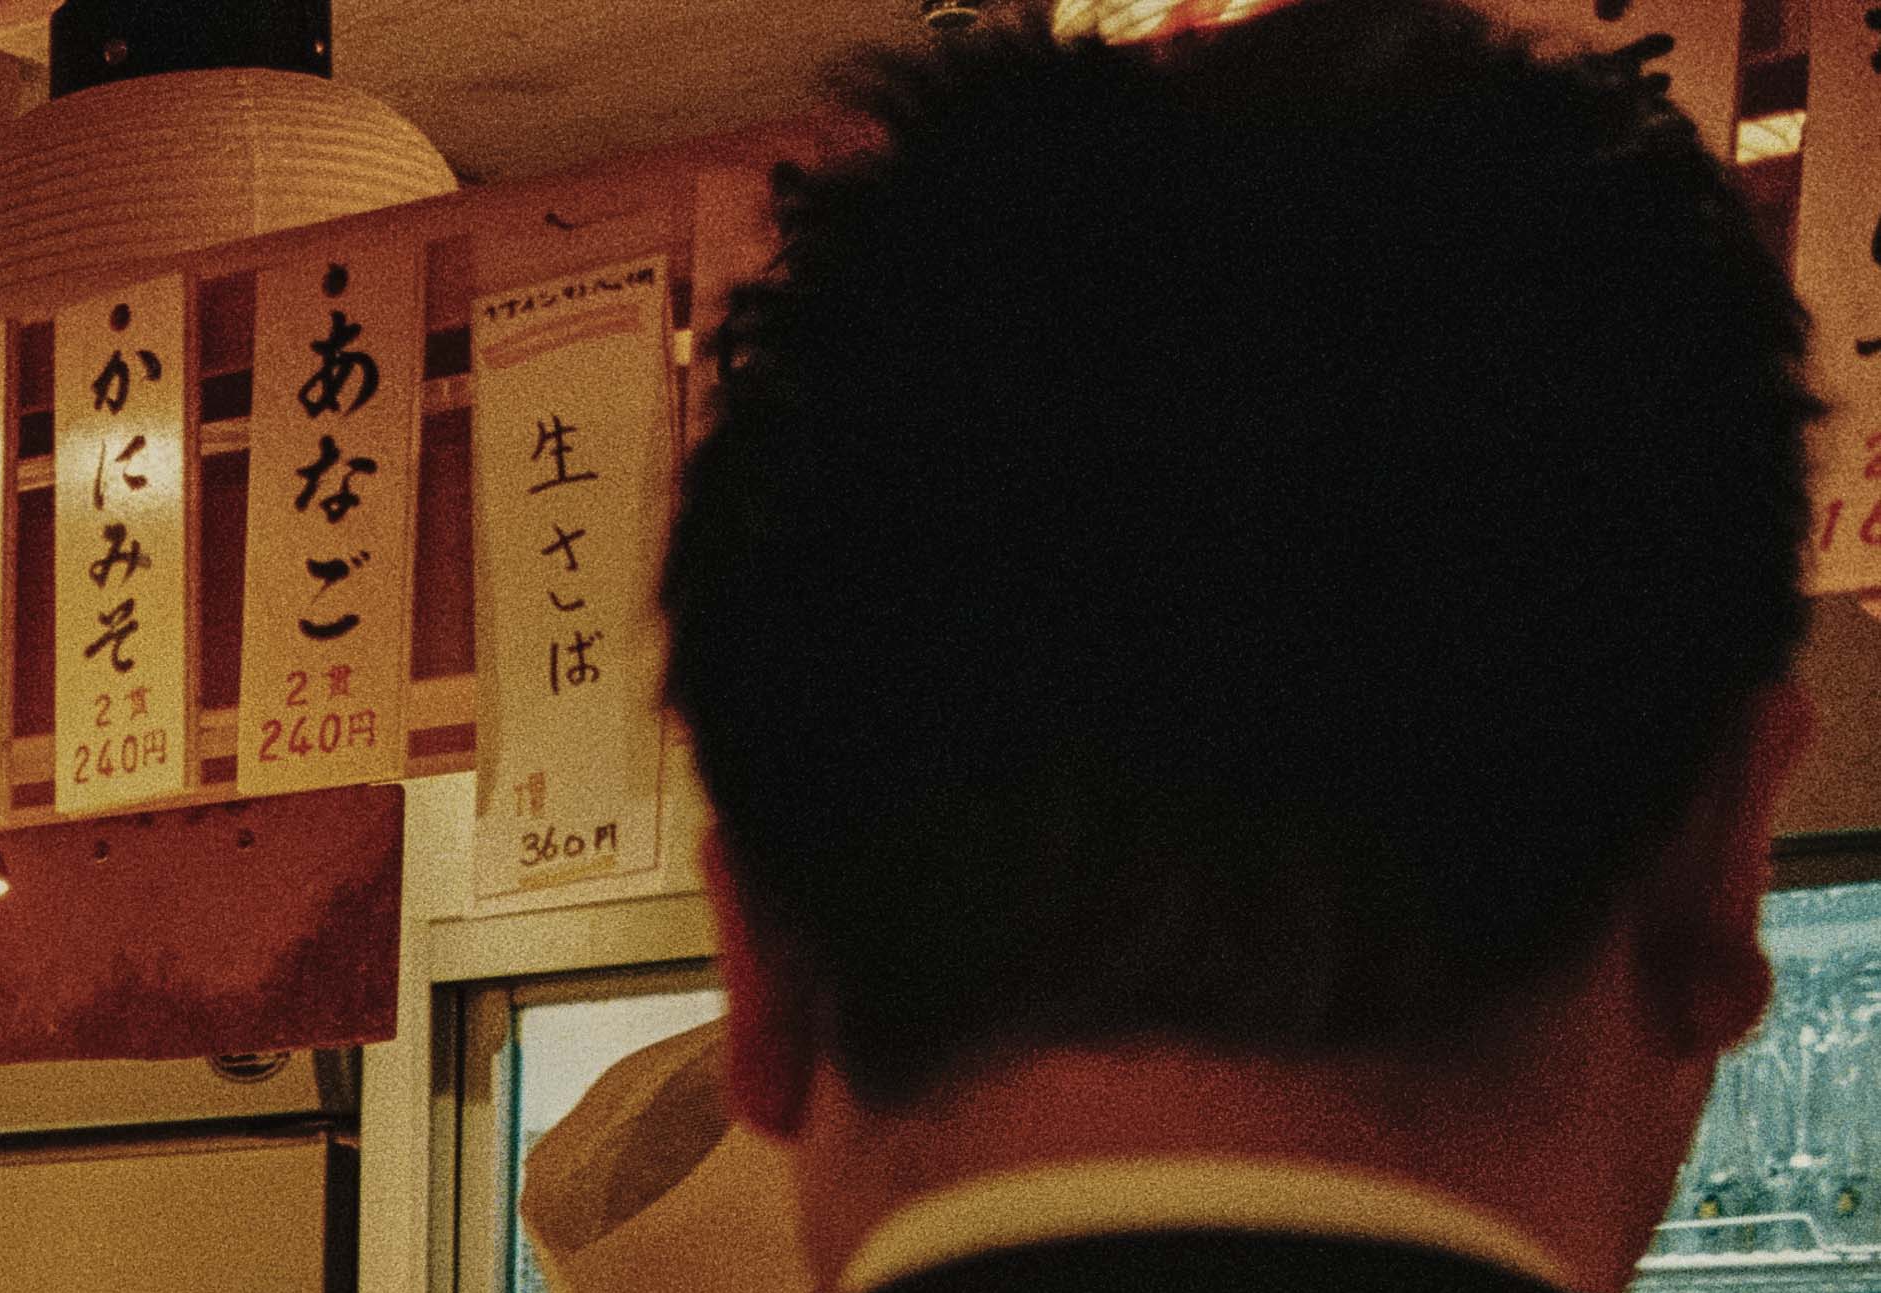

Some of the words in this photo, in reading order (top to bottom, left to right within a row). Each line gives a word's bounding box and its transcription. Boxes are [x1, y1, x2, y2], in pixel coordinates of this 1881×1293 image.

[84, 347, 164, 673] かにみそ
[294, 309, 380, 640] あなご
[528, 413, 606, 696] 生さば
[72, 729, 168, 786] 240円
[258, 709, 377, 764] 240円
[519, 824, 617, 867] 360円
